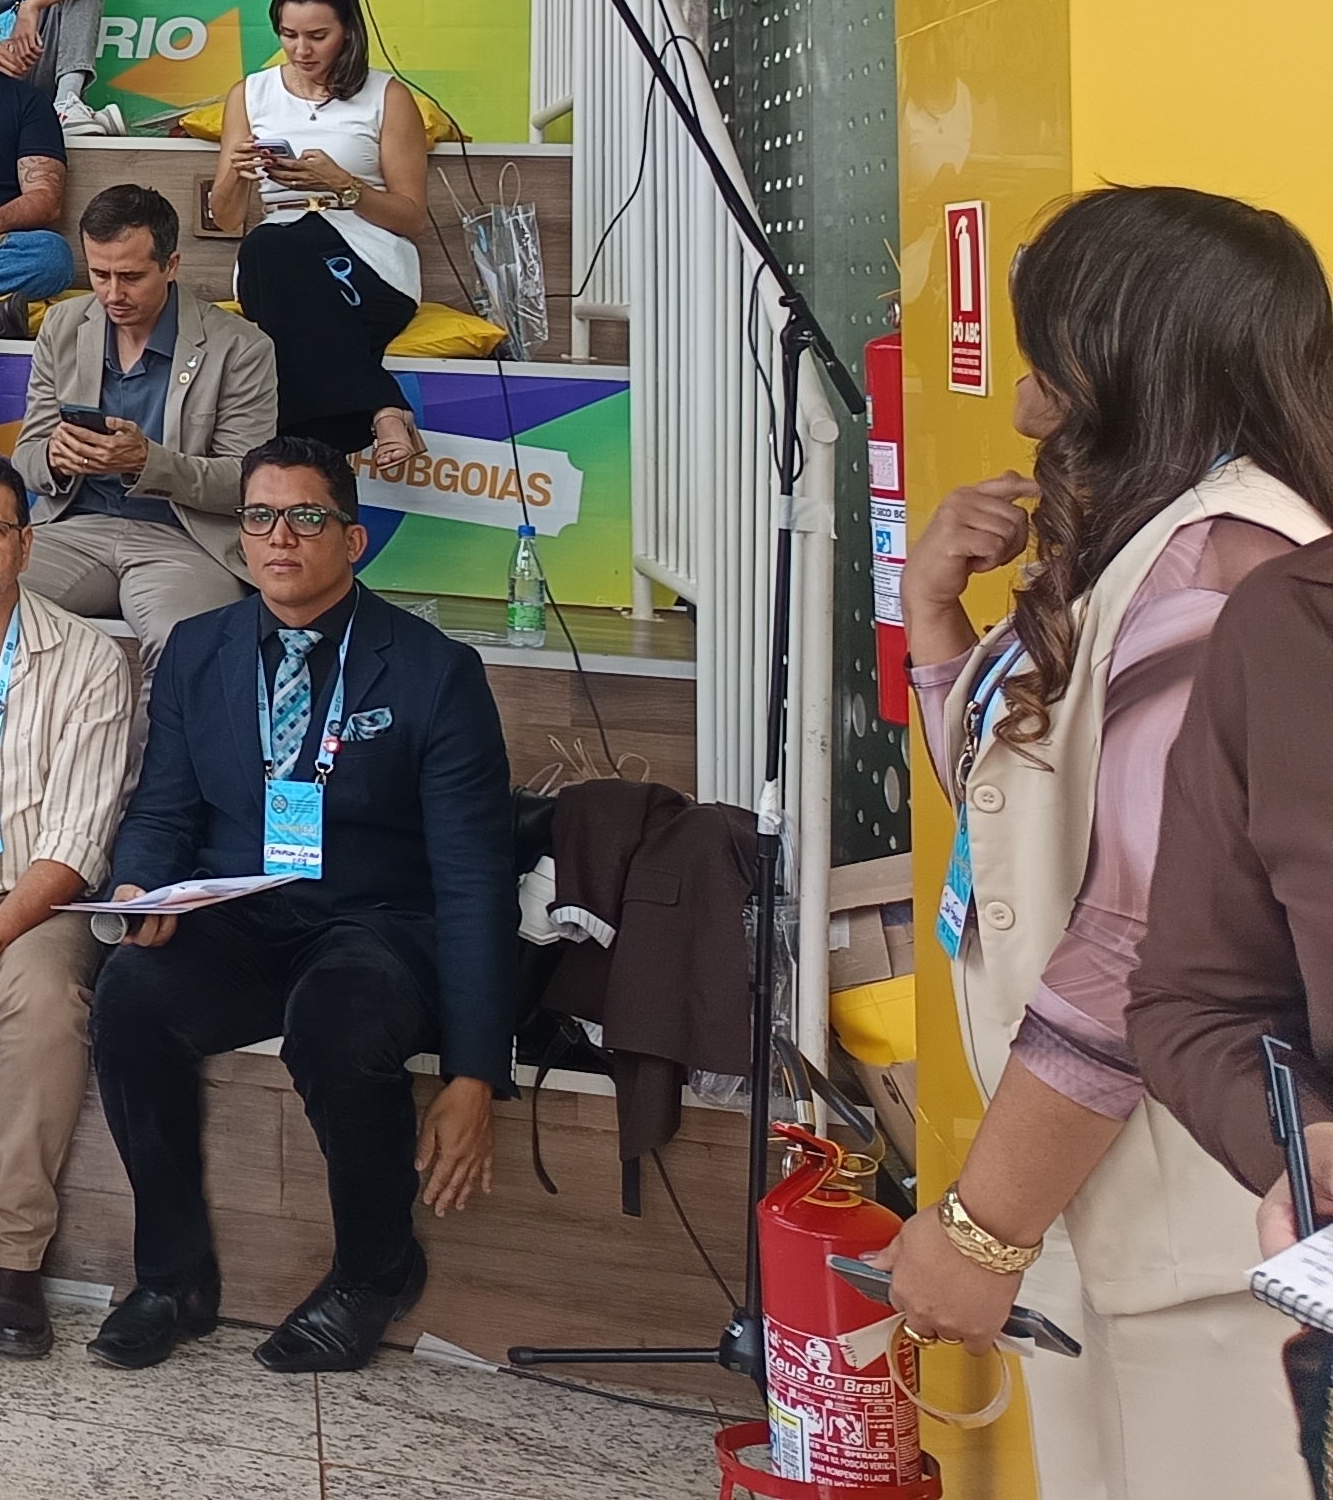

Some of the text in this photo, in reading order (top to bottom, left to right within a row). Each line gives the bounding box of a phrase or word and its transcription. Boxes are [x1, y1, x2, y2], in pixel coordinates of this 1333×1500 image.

[952, 315, 981, 344] PÓ ABC
[769, 1350, 808, 1381] Zeus
[814, 1375, 835, 1388] do
[844, 1381, 888, 1393] Brasil
[844, 1450, 889, 1461] OPERAÇÃO
